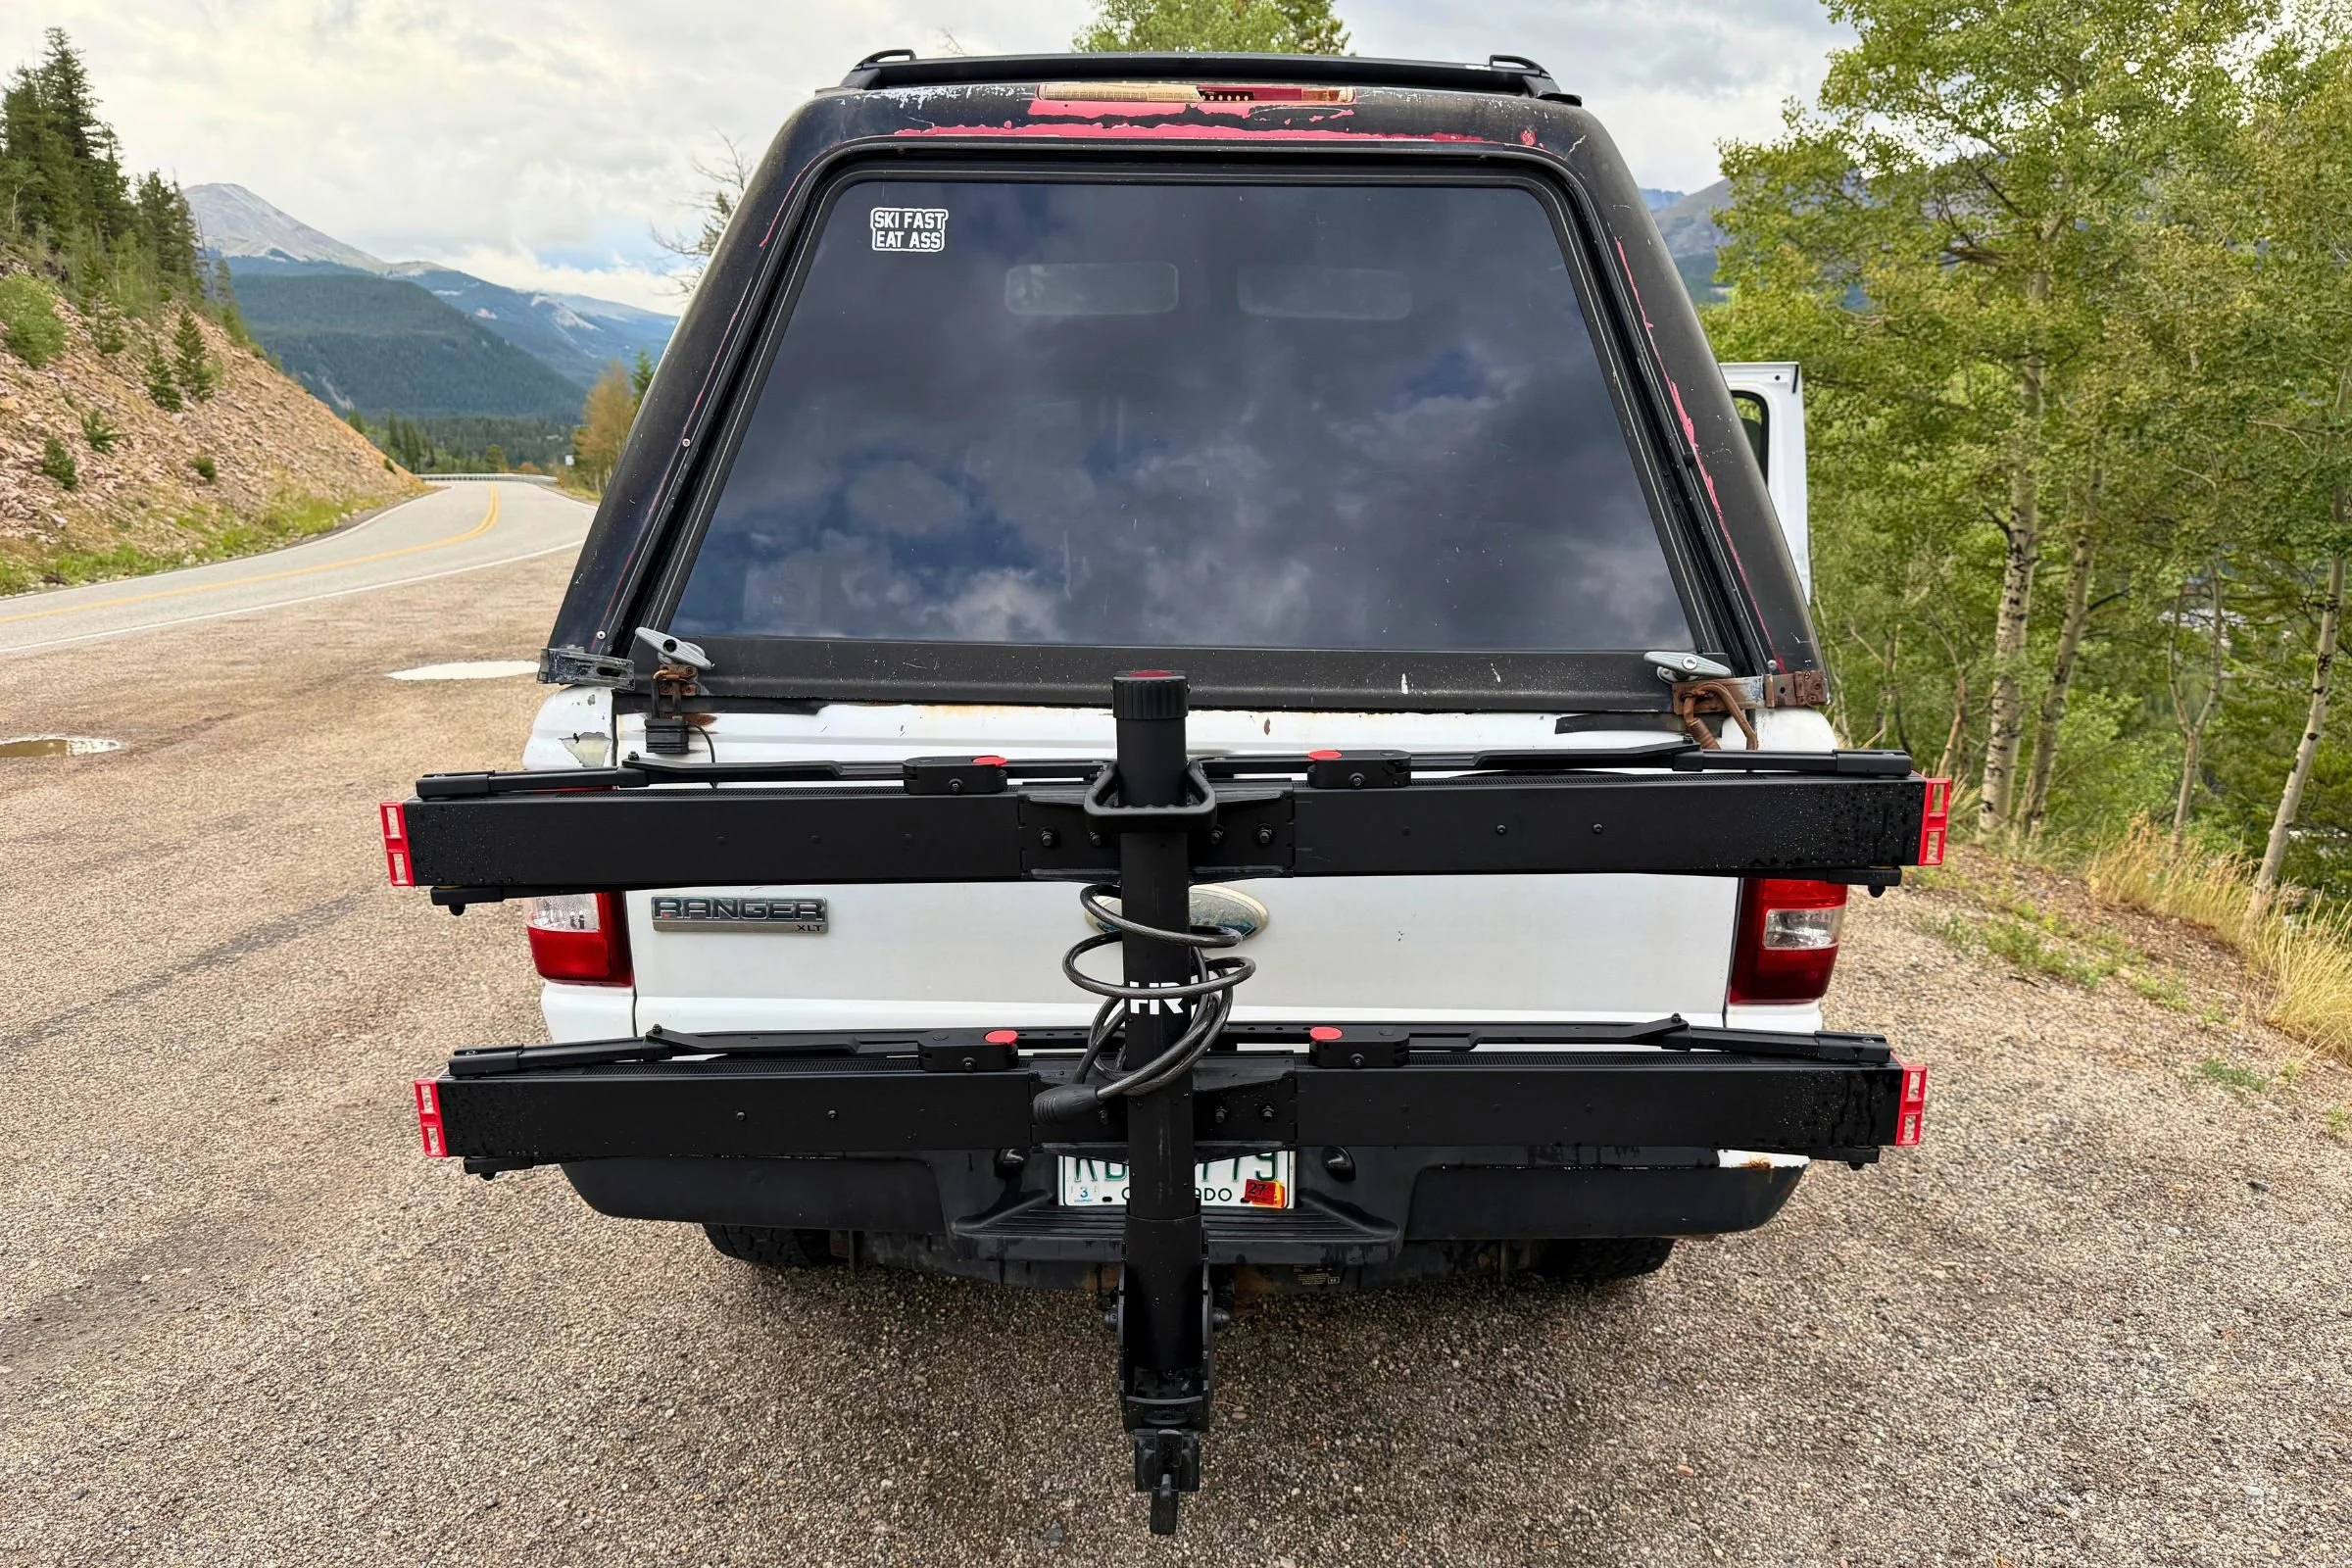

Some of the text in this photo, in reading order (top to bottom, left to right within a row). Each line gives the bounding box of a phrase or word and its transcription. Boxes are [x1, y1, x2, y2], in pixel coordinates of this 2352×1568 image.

[874, 211, 945, 229] SKI FAST
[876, 230, 941, 249] EAT ASS
[654, 899, 823, 921] RANGER
[1248, 1181, 1266, 1196] 27
